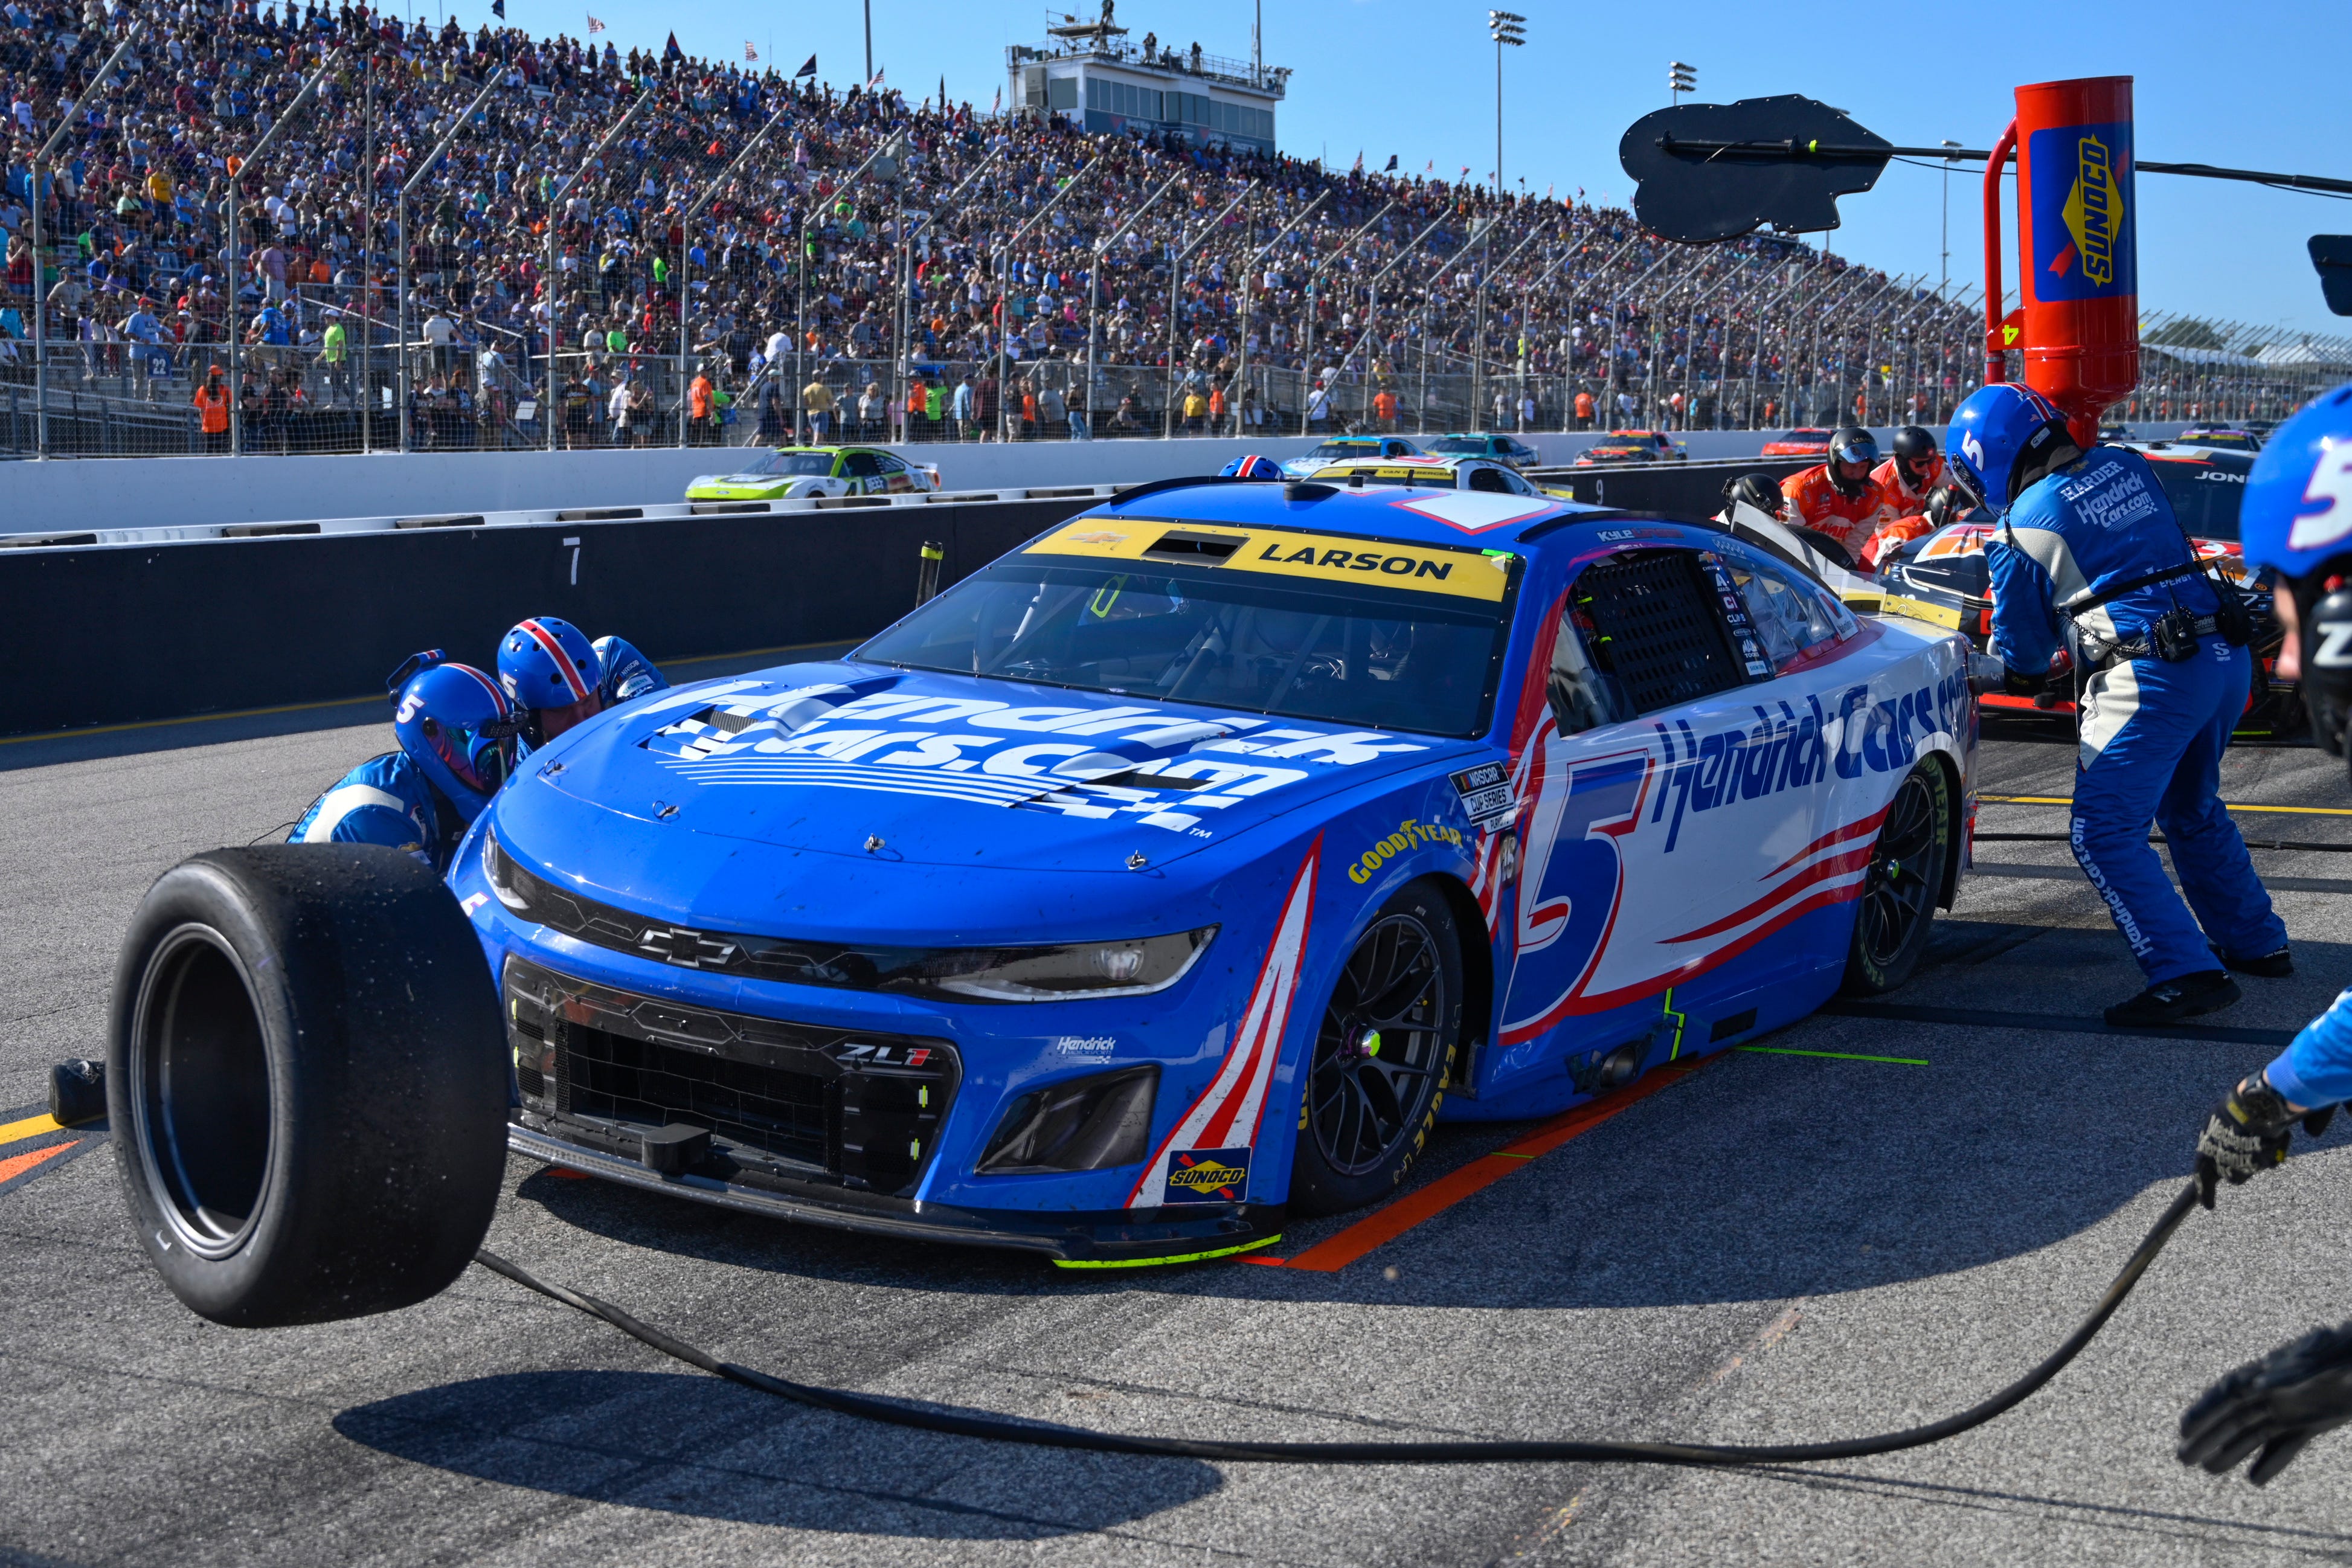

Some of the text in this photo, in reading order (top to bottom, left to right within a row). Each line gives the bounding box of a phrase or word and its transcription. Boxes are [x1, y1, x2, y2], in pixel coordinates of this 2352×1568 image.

[2082, 140, 2112, 281] SUNOCO
[2001, 324, 2019, 346] 4
[152, 358, 166, 374] 22
[1961, 429, 1984, 472] 5
[2060, 460, 2125, 501] HARDER
[2194, 471, 2250, 484] JON
[1595, 483, 1604, 505] 9
[2075, 471, 2145, 525] Hendrick
[2287, 436, 2352, 550] 5
[2100, 490, 2153, 529] Cars.com
[562, 536, 581, 586] 7
[1258, 543, 1454, 580] LARSON
[2211, 643, 2230, 656] S
[621, 660, 640, 676] NASCAR
[501, 672, 519, 699] 5
[396, 694, 425, 724] 5
[1470, 766, 1499, 788] NASCAR
[1470, 788, 1507, 813] CUP SERIES
[1188, 827, 1213, 839] TM
[1498, 748, 1656, 1046] 5
[836, 1043, 931, 1066] ZL1
[1056, 1036, 1117, 1055] Hendrick
[1414, 1043, 1456, 1156] EAGLE
[1172, 1168, 1244, 1187] SUNOCO
